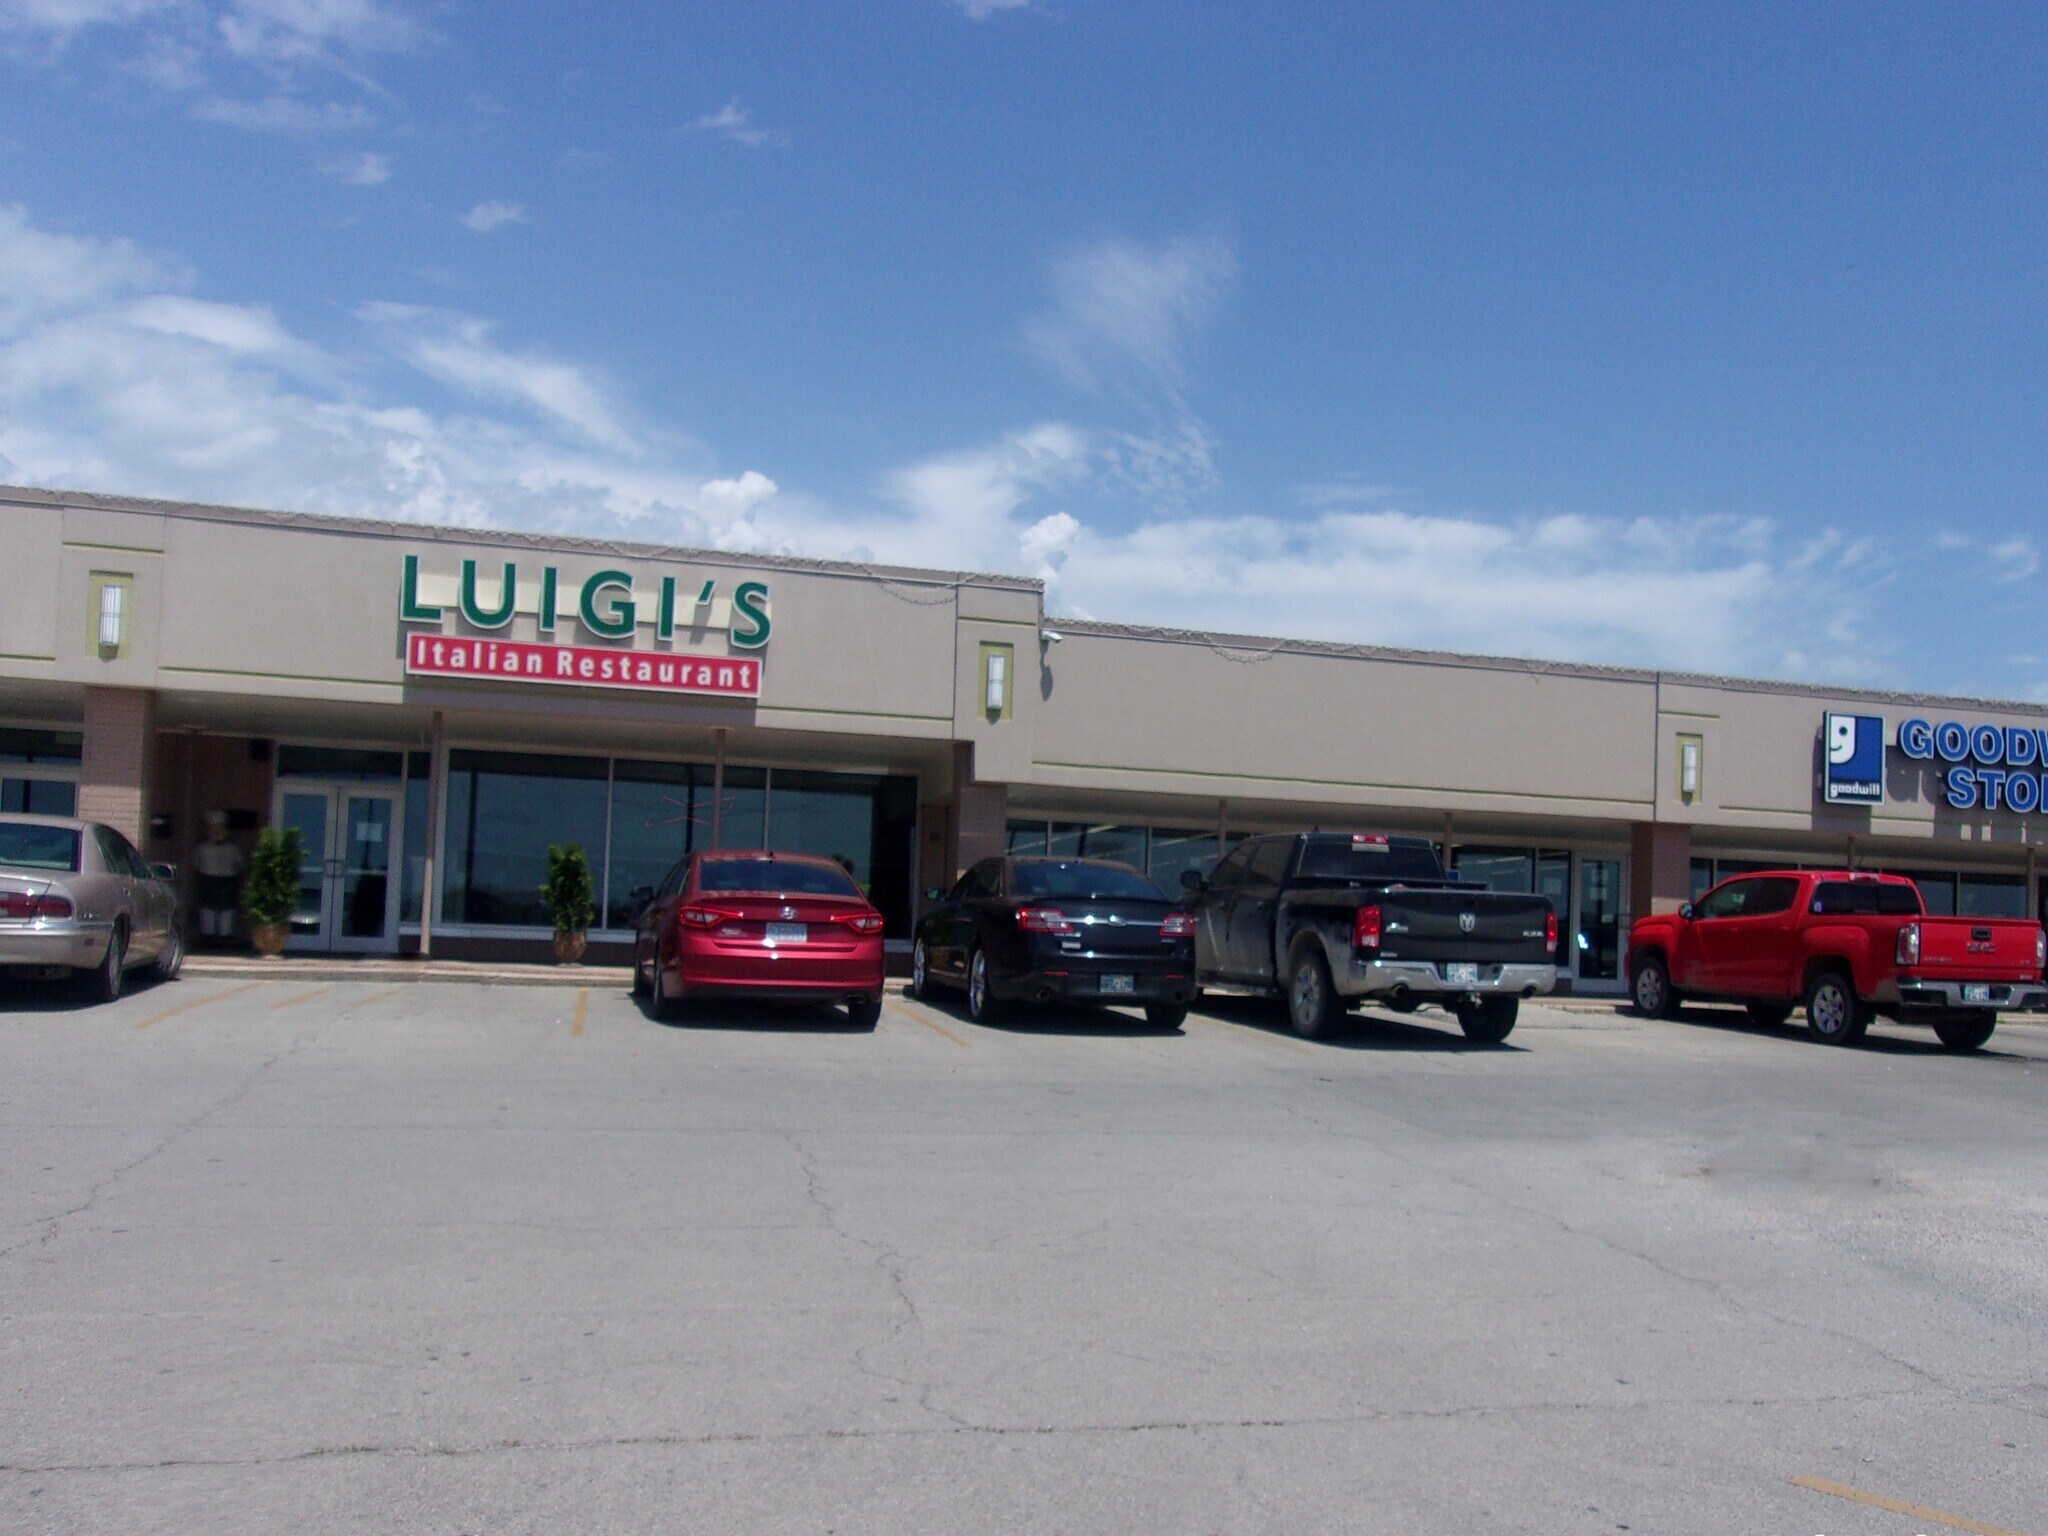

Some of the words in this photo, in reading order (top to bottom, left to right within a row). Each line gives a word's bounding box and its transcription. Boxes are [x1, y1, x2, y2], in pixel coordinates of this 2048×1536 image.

[401, 554, 772, 649] LUIGI'S
[416, 638, 544, 675] Italian
[556, 649, 751, 689] Restaurant
[1900, 718, 2048, 768] GOOD
[1829, 781, 1880, 798] goodwill
[1948, 767, 2048, 813] STO
